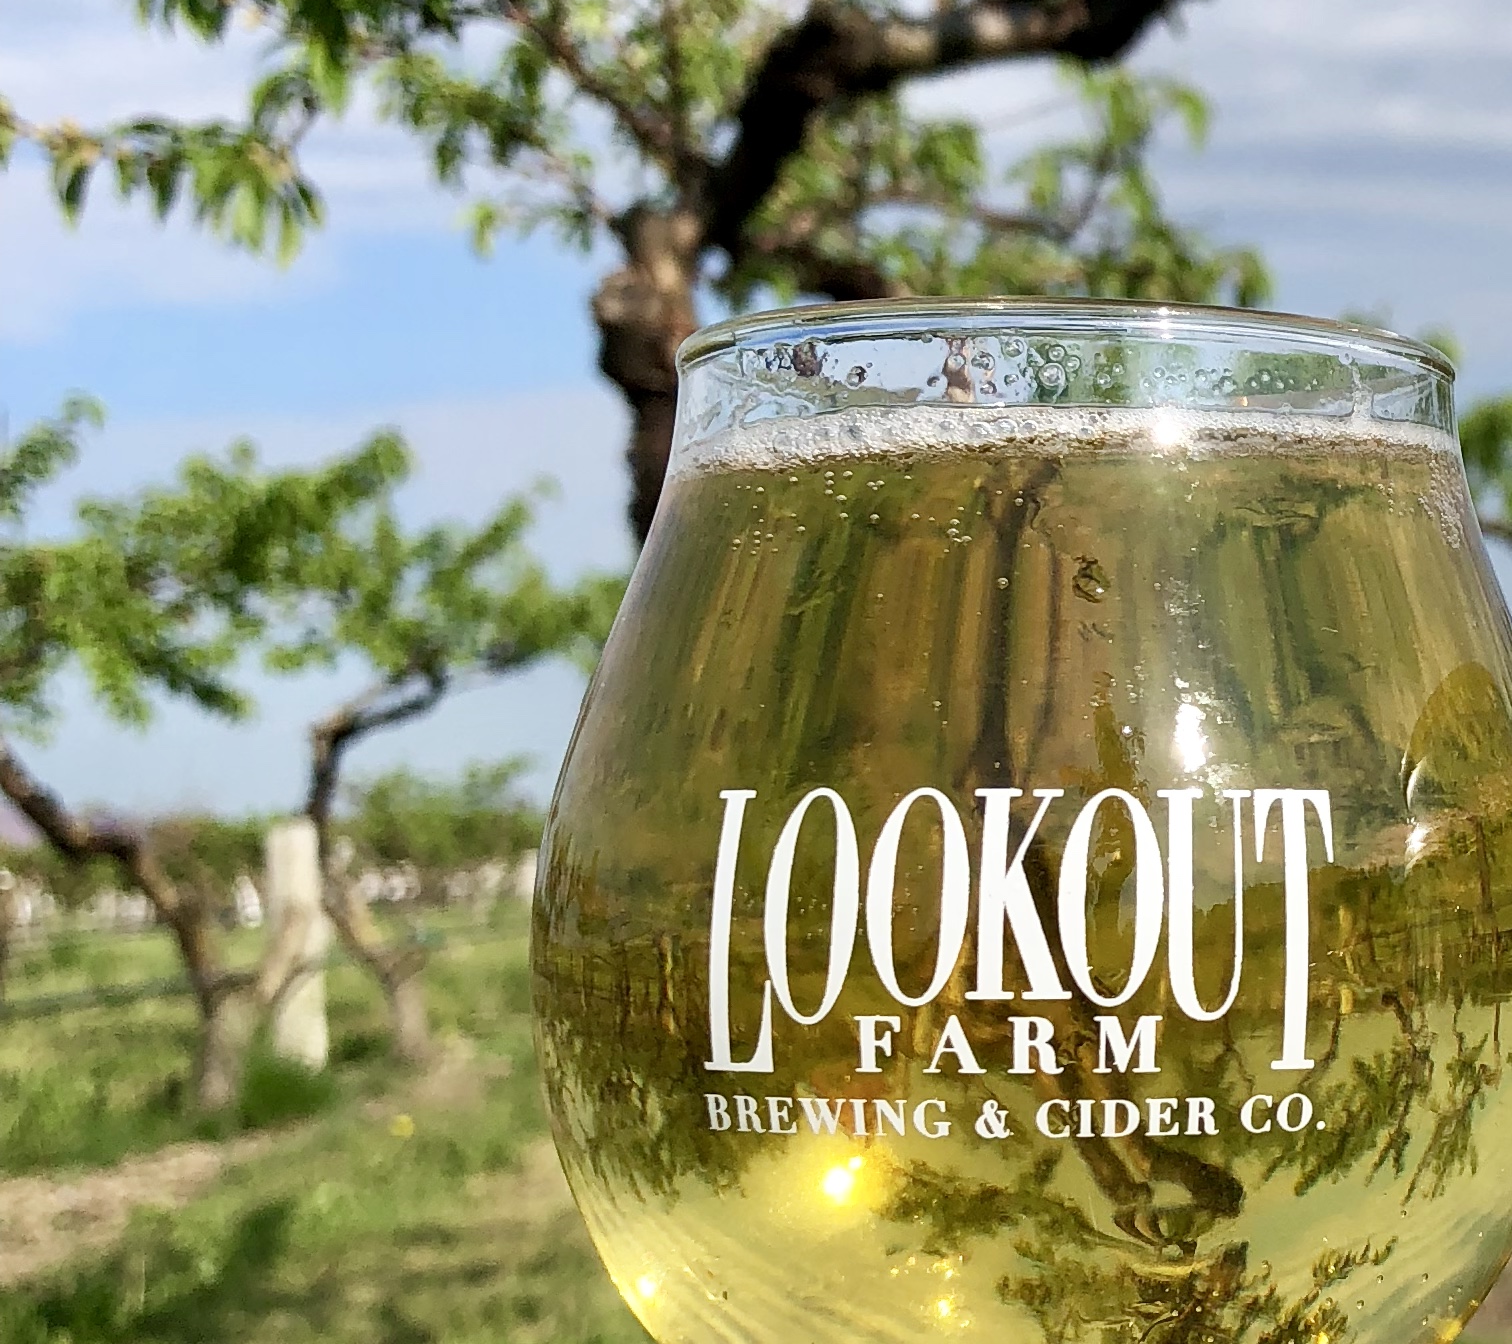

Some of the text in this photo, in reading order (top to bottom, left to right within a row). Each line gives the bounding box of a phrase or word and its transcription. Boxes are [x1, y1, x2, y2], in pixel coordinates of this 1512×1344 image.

[703, 786, 1335, 1074] LOOKOUT
[854, 1014, 1163, 1076] FARM
[703, 1092, 1327, 1140] BREWING & CIDER CO.
